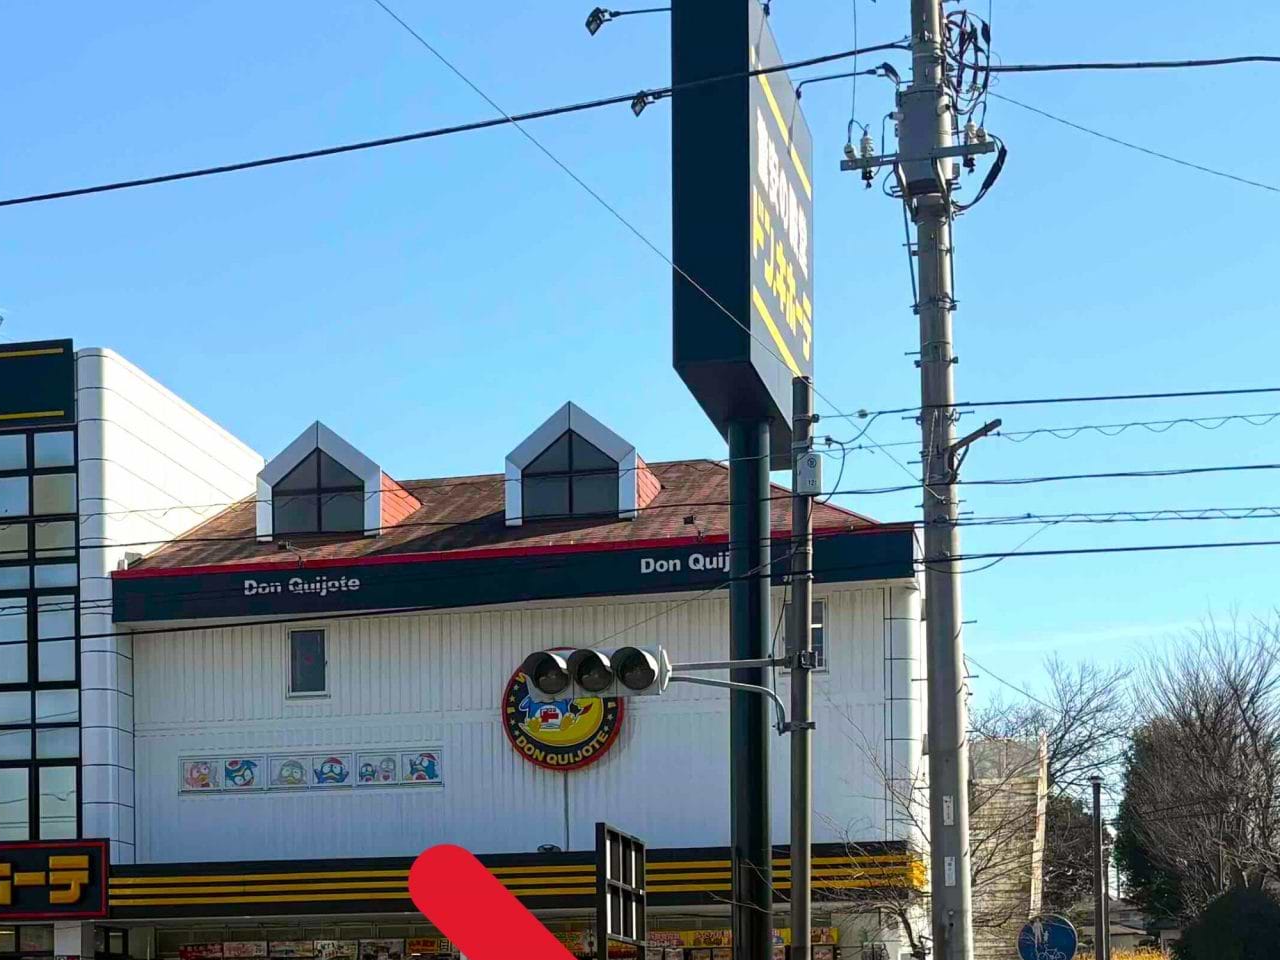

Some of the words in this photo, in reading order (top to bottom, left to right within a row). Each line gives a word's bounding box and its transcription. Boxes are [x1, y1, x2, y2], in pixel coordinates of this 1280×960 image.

[640, 556, 681, 574] Don
[687, 551, 731, 572] Quij
[244, 579, 282, 596] Don
[288, 575, 360, 597] Quijote
[516, 735, 546, 762] DON
[546, 730, 609, 766] QUIJOTE
